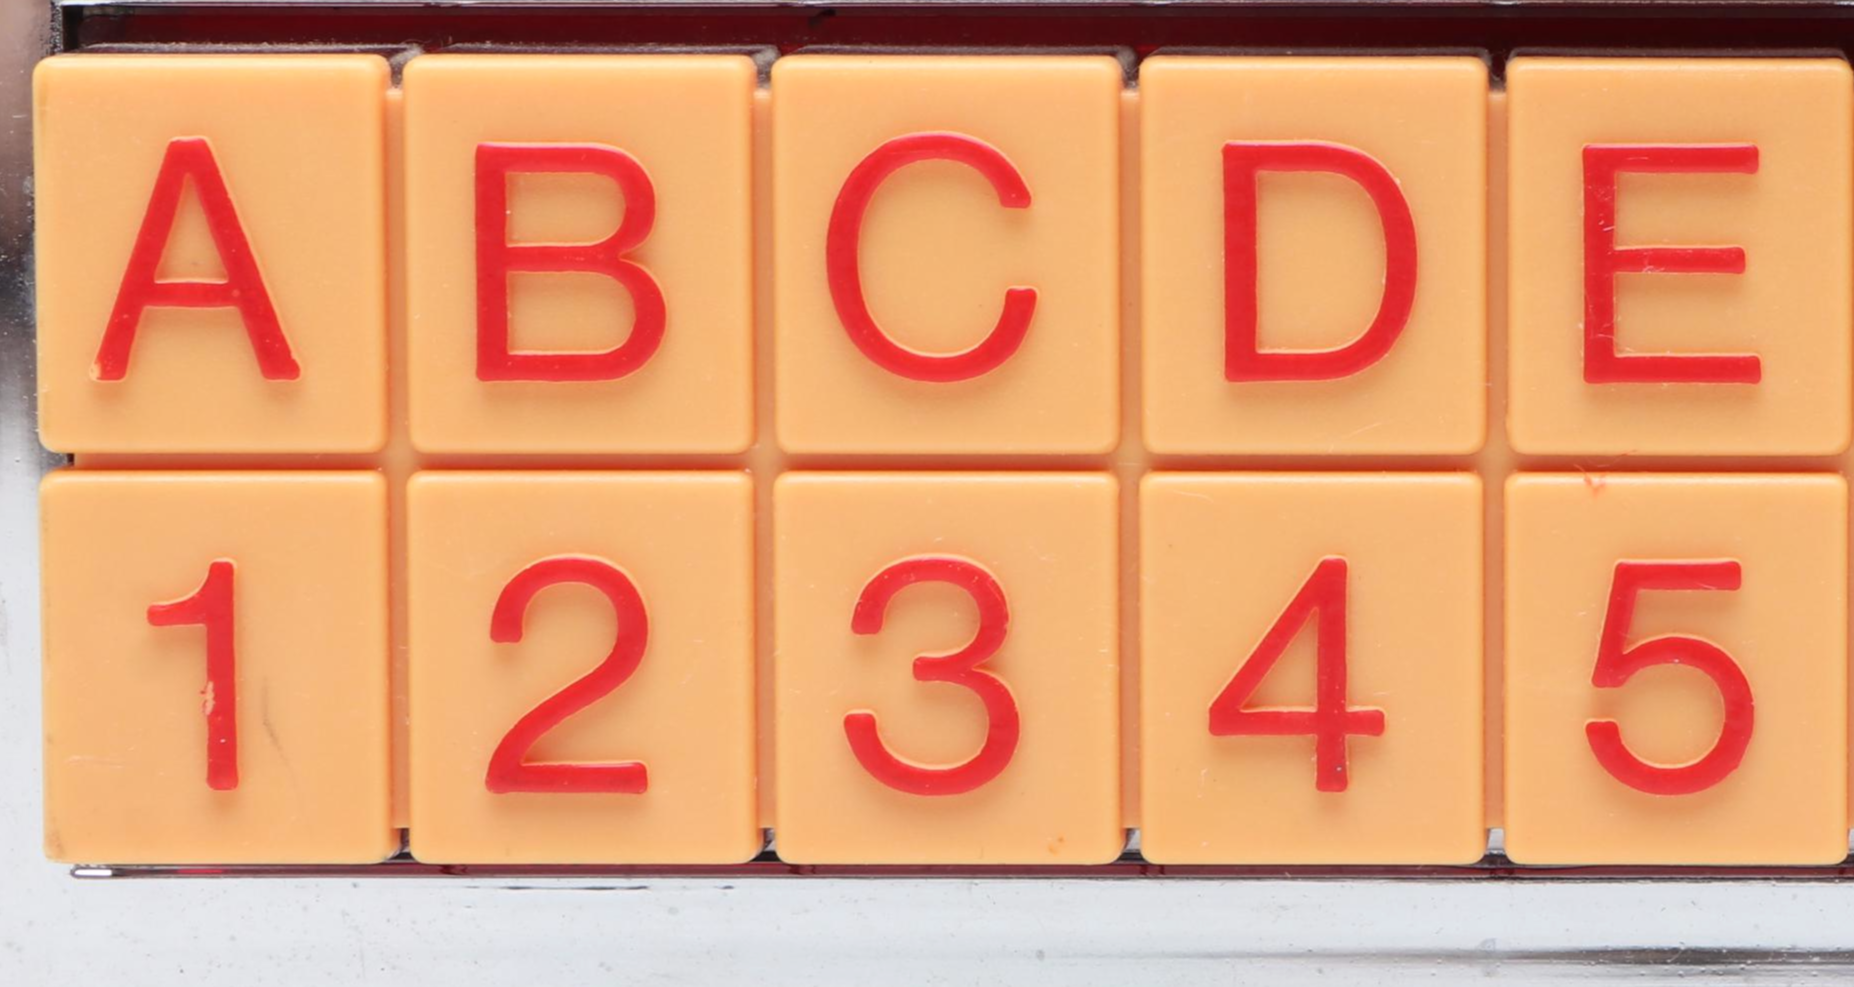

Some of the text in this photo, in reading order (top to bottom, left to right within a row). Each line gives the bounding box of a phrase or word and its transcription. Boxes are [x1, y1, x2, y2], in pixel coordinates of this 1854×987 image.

[92, 136, 302, 382] A
[474, 143, 667, 383] B
[825, 132, 1038, 383] C
[1221, 142, 1418, 383] D
[1581, 144, 1762, 385] E
[147, 559, 238, 791] 1
[485, 556, 649, 796] 2
[843, 557, 1020, 797] 3
[1208, 557, 1386, 793] 4
[1584, 559, 1755, 796] 5
